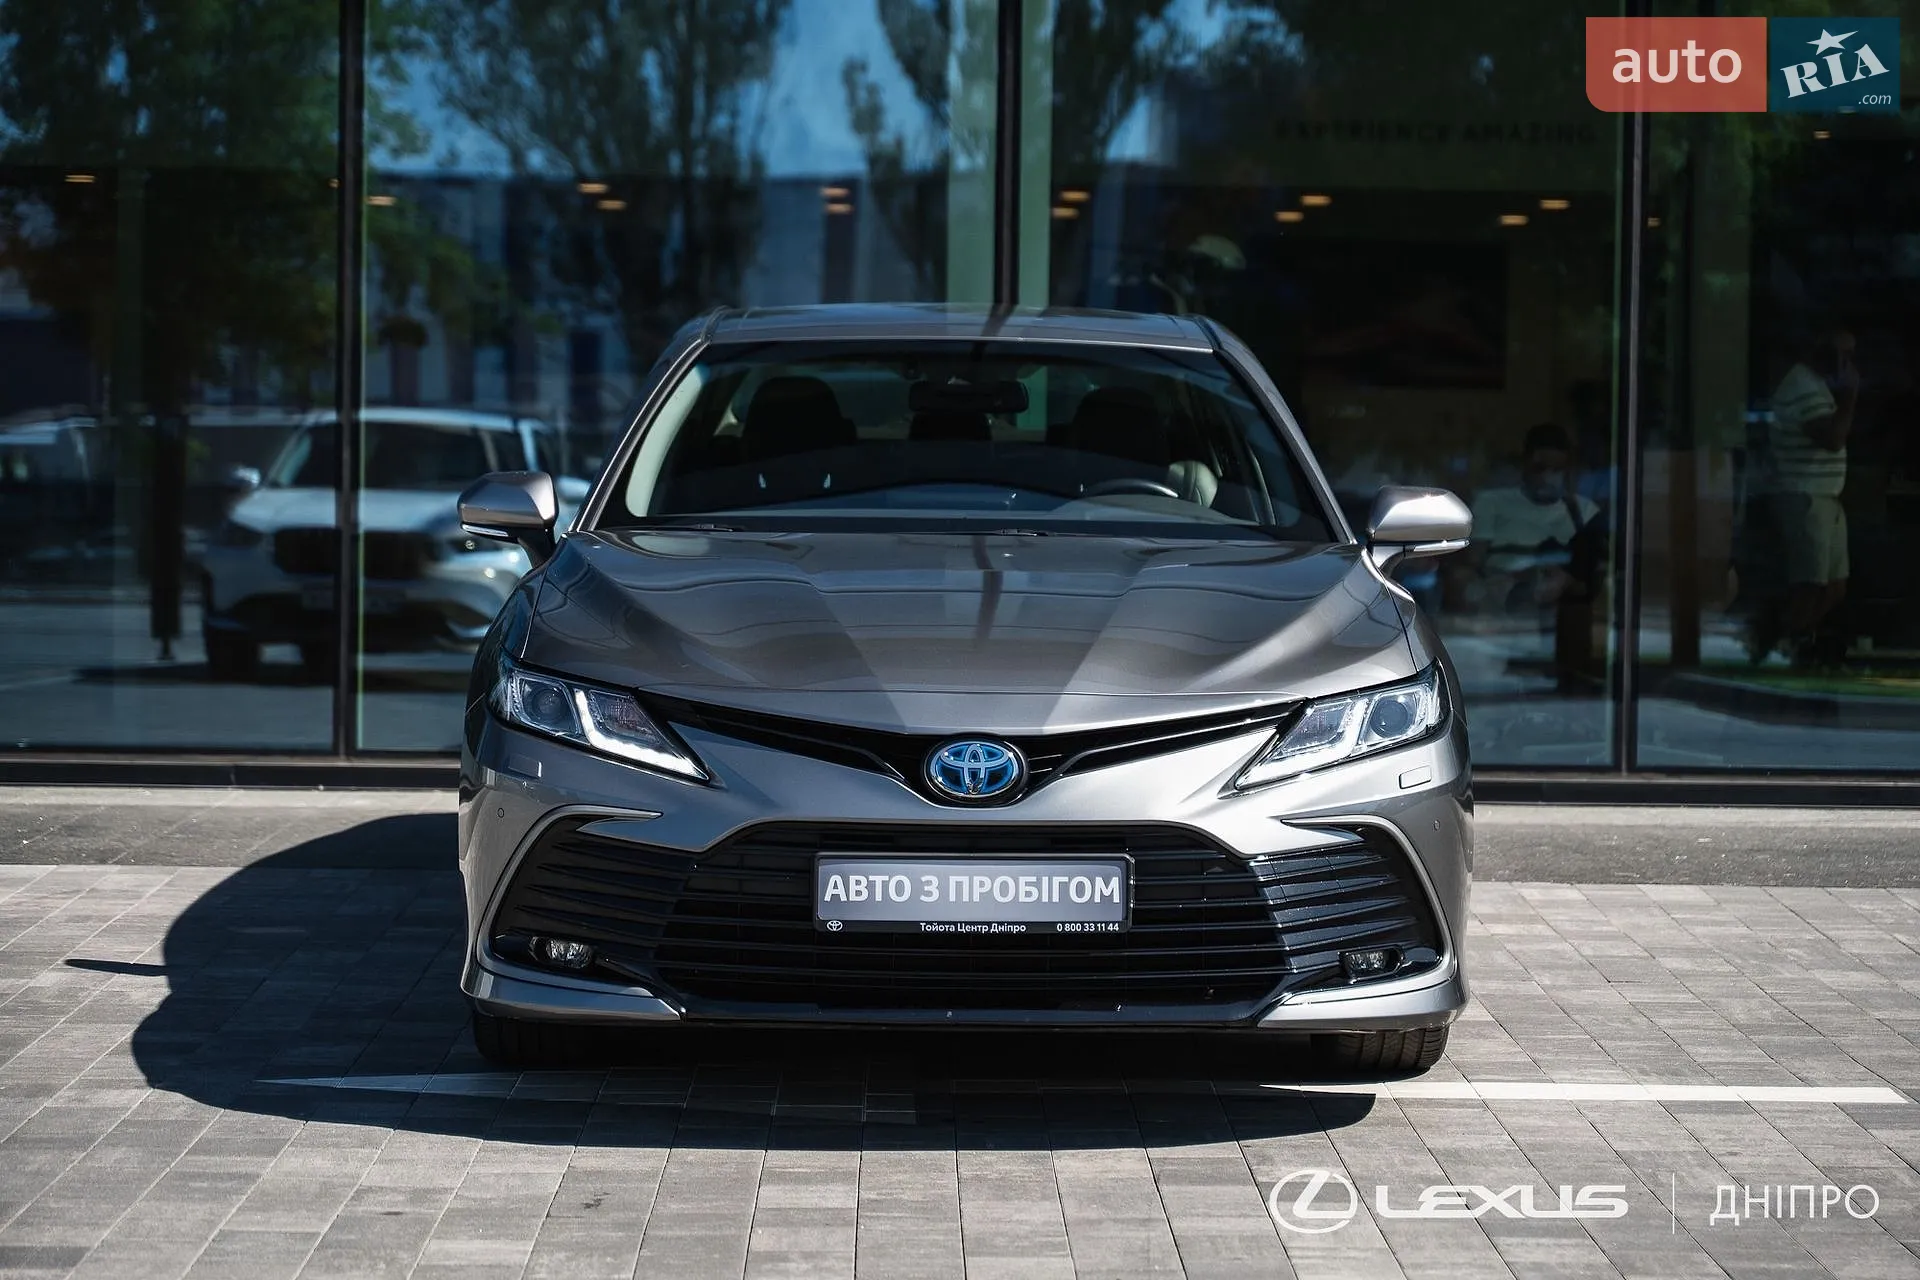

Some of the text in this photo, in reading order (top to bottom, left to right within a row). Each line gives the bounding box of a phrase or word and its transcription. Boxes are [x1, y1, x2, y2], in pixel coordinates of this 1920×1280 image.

[823, 874, 912, 902] АВТО
[948, 874, 1121, 904] ПРОБІГОМ
[920, 922, 1027, 934] Тойота Центр Дніпро
[1056, 922, 1063, 932] 0
[1064, 922, 1082, 932] 800
[1083, 922, 1096, 932] 33
